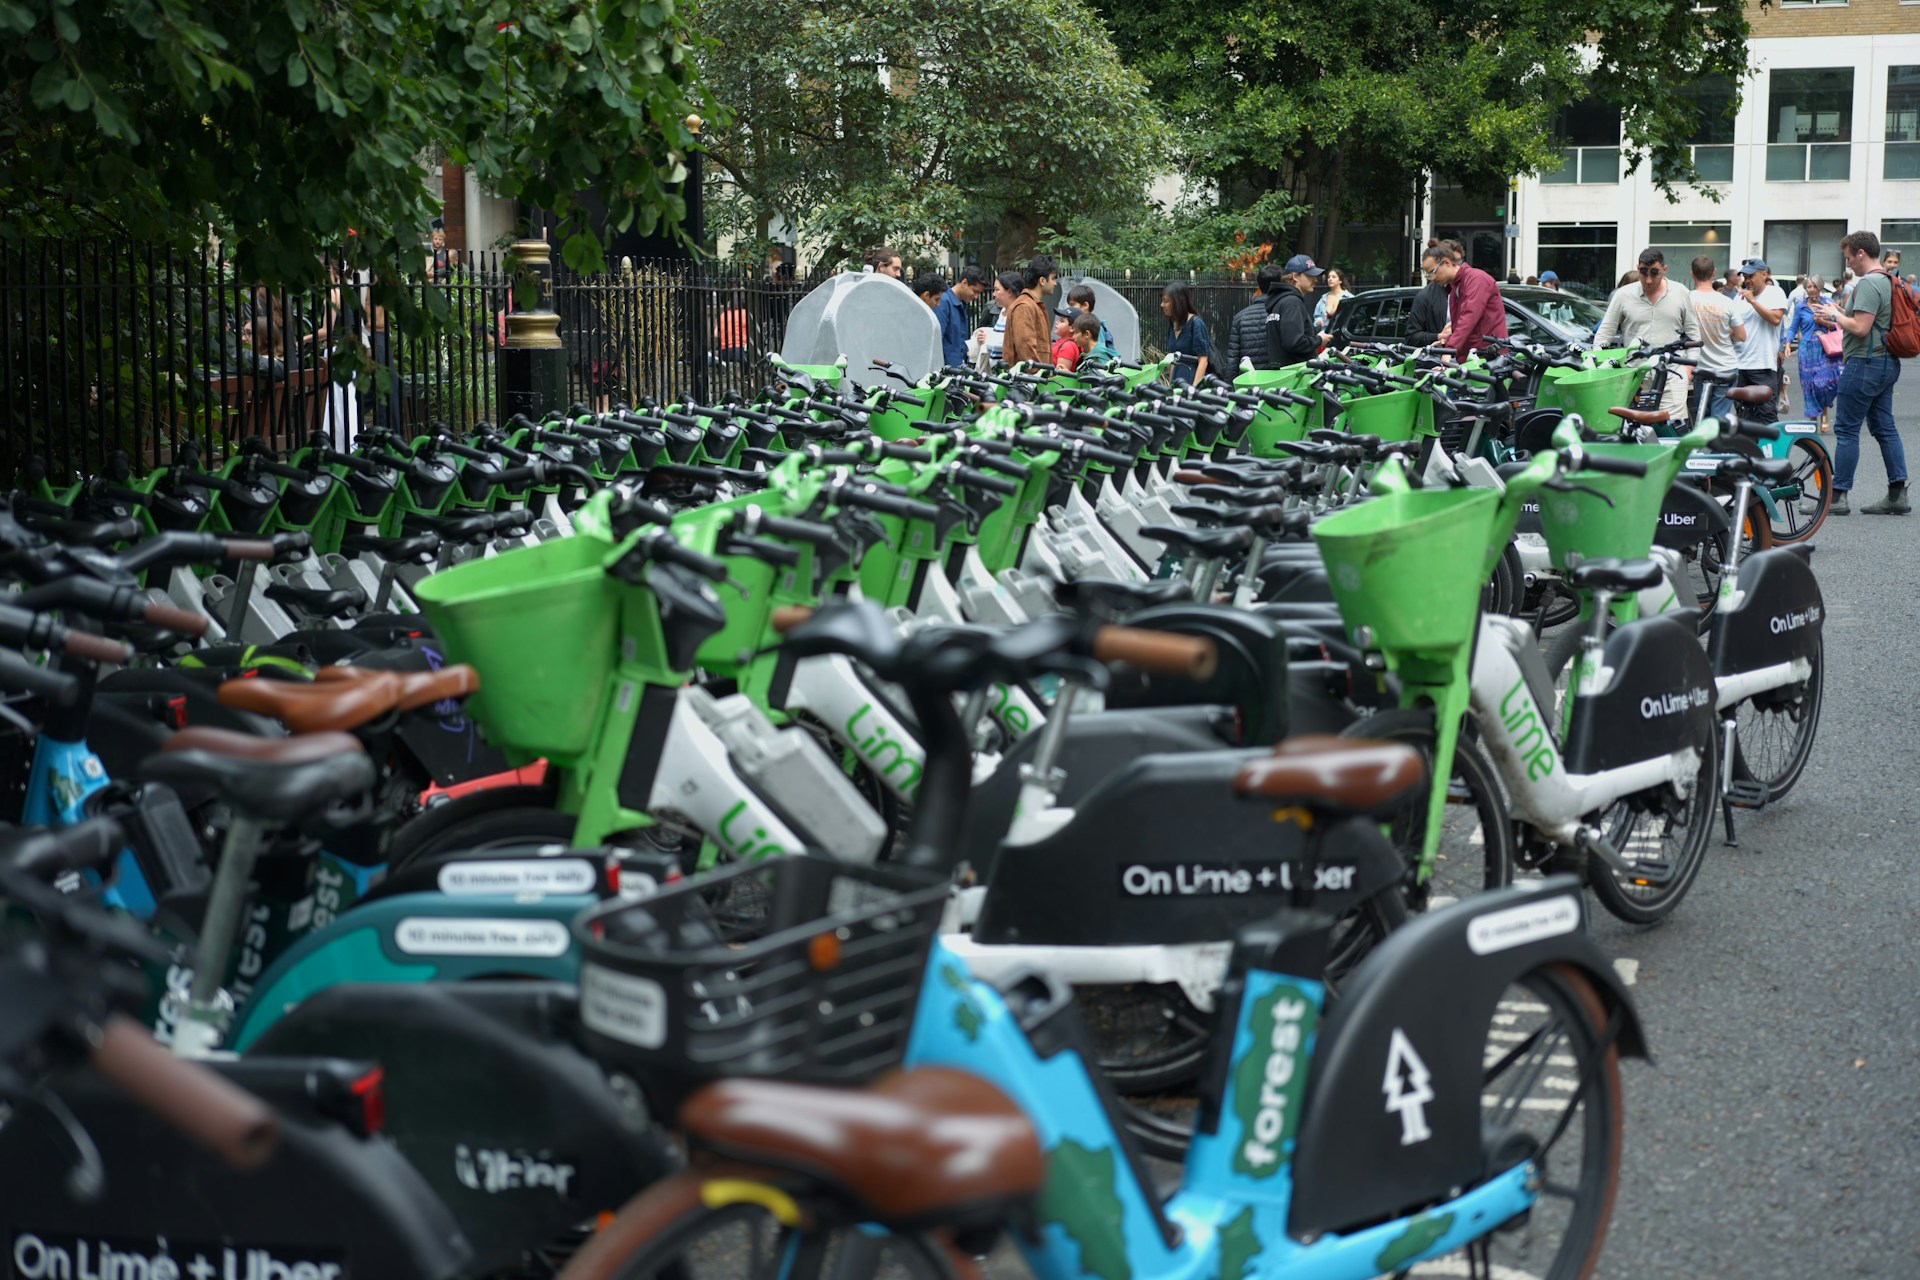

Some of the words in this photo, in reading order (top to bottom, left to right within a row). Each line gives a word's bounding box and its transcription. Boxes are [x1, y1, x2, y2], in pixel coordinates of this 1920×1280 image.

[1664, 513, 1697, 525] Uber
[1770, 616, 1788, 634] On
[1785, 612, 1806, 630] Lime
[1640, 696, 1664, 719] On
[1661, 692, 1689, 715] Lime
[1499, 677, 1554, 783] Lime
[845, 703, 922, 800] Lim
[1122, 864, 1173, 896] On
[1175, 863, 1252, 895] Lime
[1243, 996, 1306, 1169] forest
[14, 1233, 71, 1280] On
